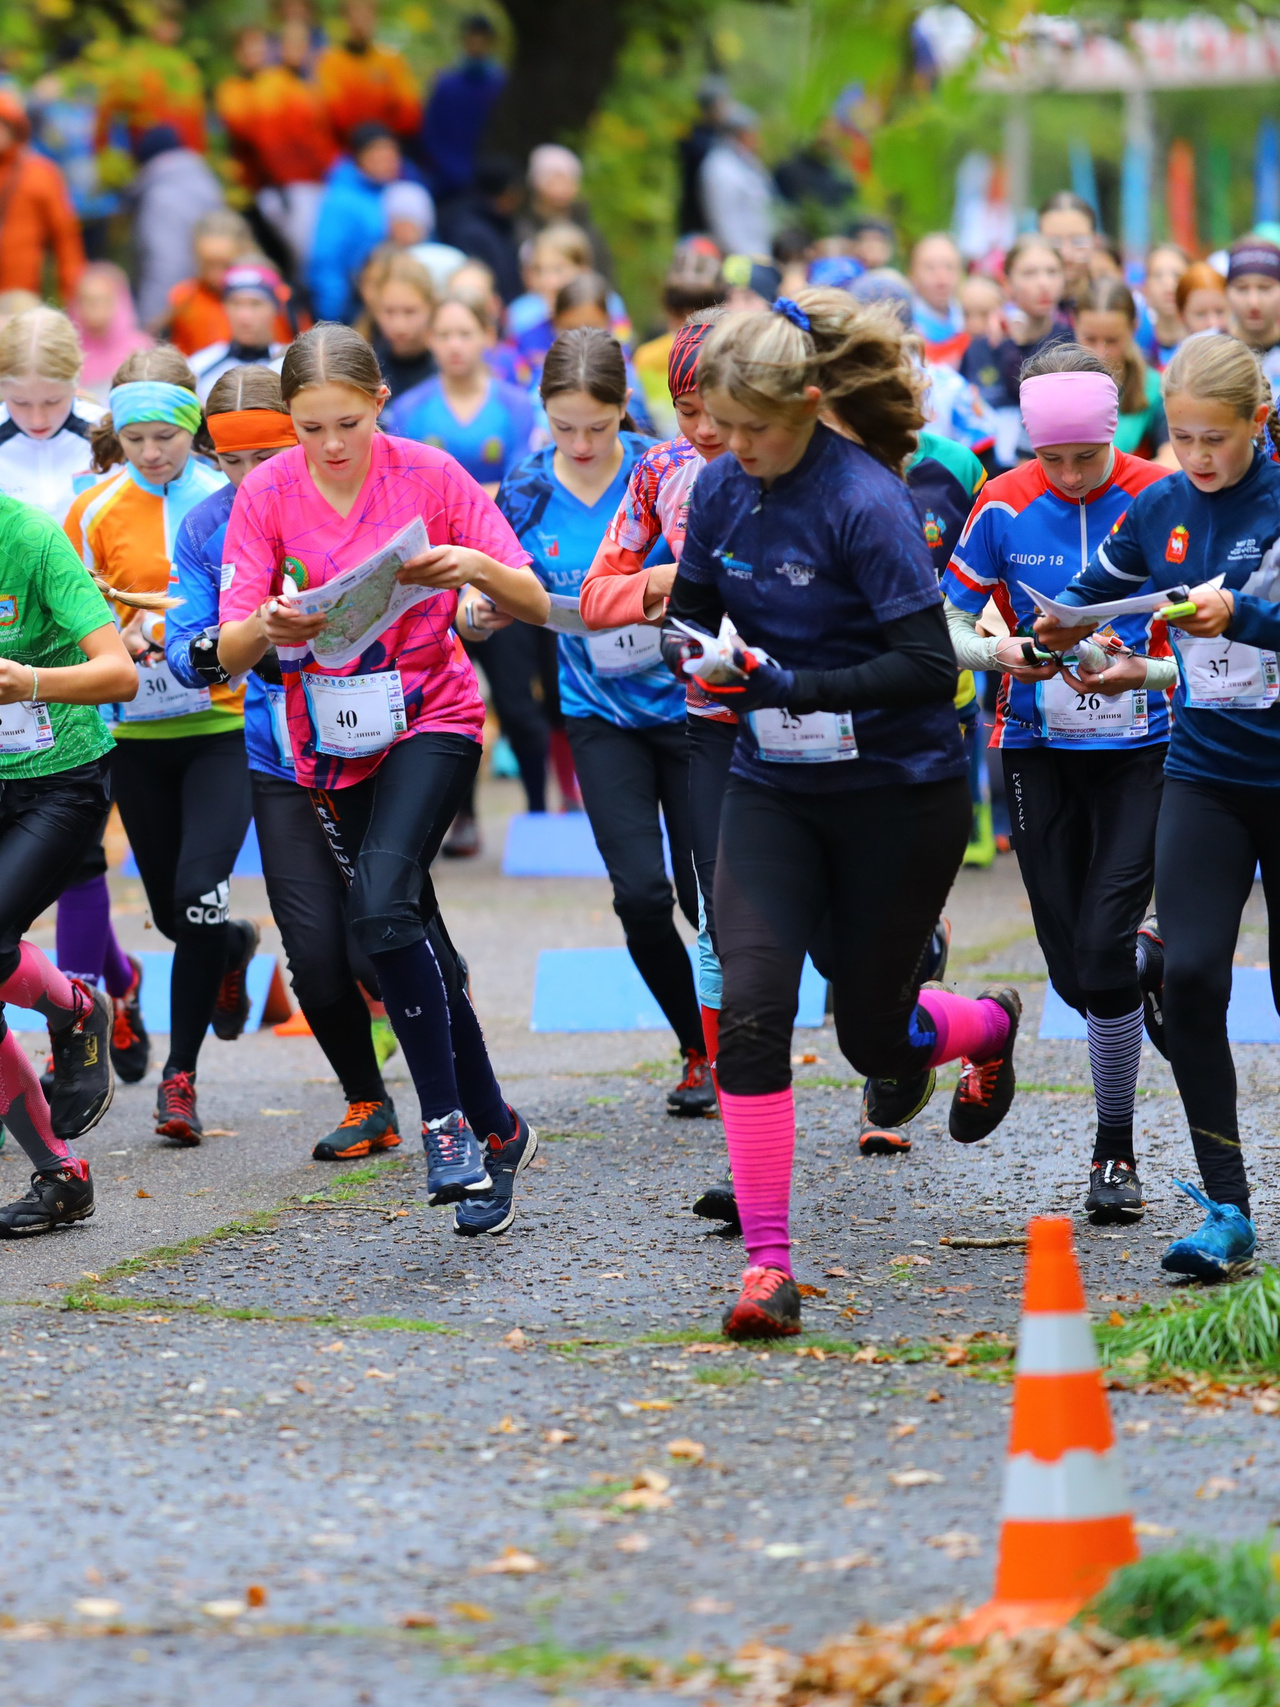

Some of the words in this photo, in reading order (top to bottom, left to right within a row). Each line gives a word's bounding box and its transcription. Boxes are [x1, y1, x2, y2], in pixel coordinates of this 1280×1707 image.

[1009, 553, 1045, 566] СШОР
[1049, 555, 1064, 566] 18
[614, 634, 635, 649] 41
[1208, 659, 1229, 679] 37
[145, 677, 167, 696] 30
[1075, 693, 1101, 711] 26
[336, 709, 358, 729] 40
[1088, 713, 1093, 721] 2
[0, 728, 26, 737] линия
[347, 731, 352, 739] 2
[353, 730, 381, 739] линия
[317, 806, 355, 887] СЕГДА
